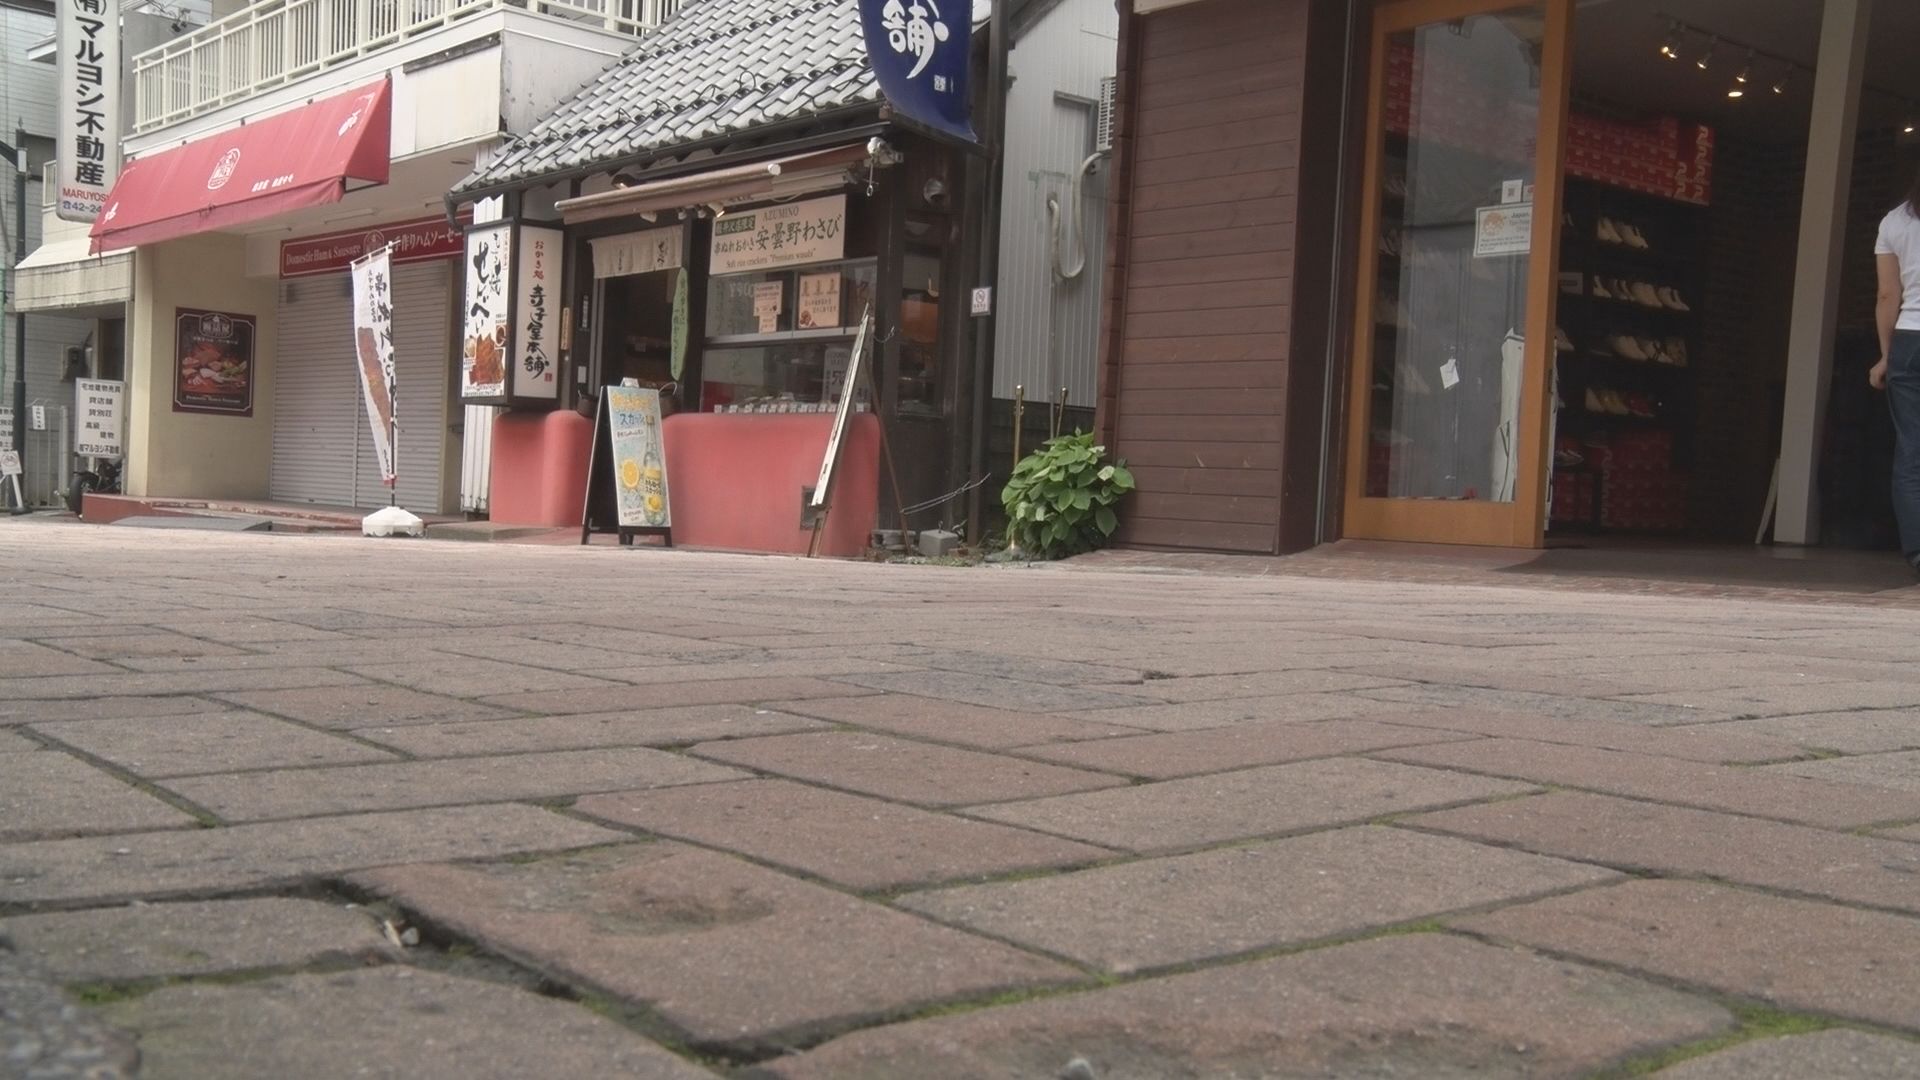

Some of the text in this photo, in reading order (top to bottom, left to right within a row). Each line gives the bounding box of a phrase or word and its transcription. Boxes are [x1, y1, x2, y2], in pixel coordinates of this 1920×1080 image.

[394, 228, 465, 253] 手作りハムソーセー
[756, 213, 842, 250] 安曇野わさび
